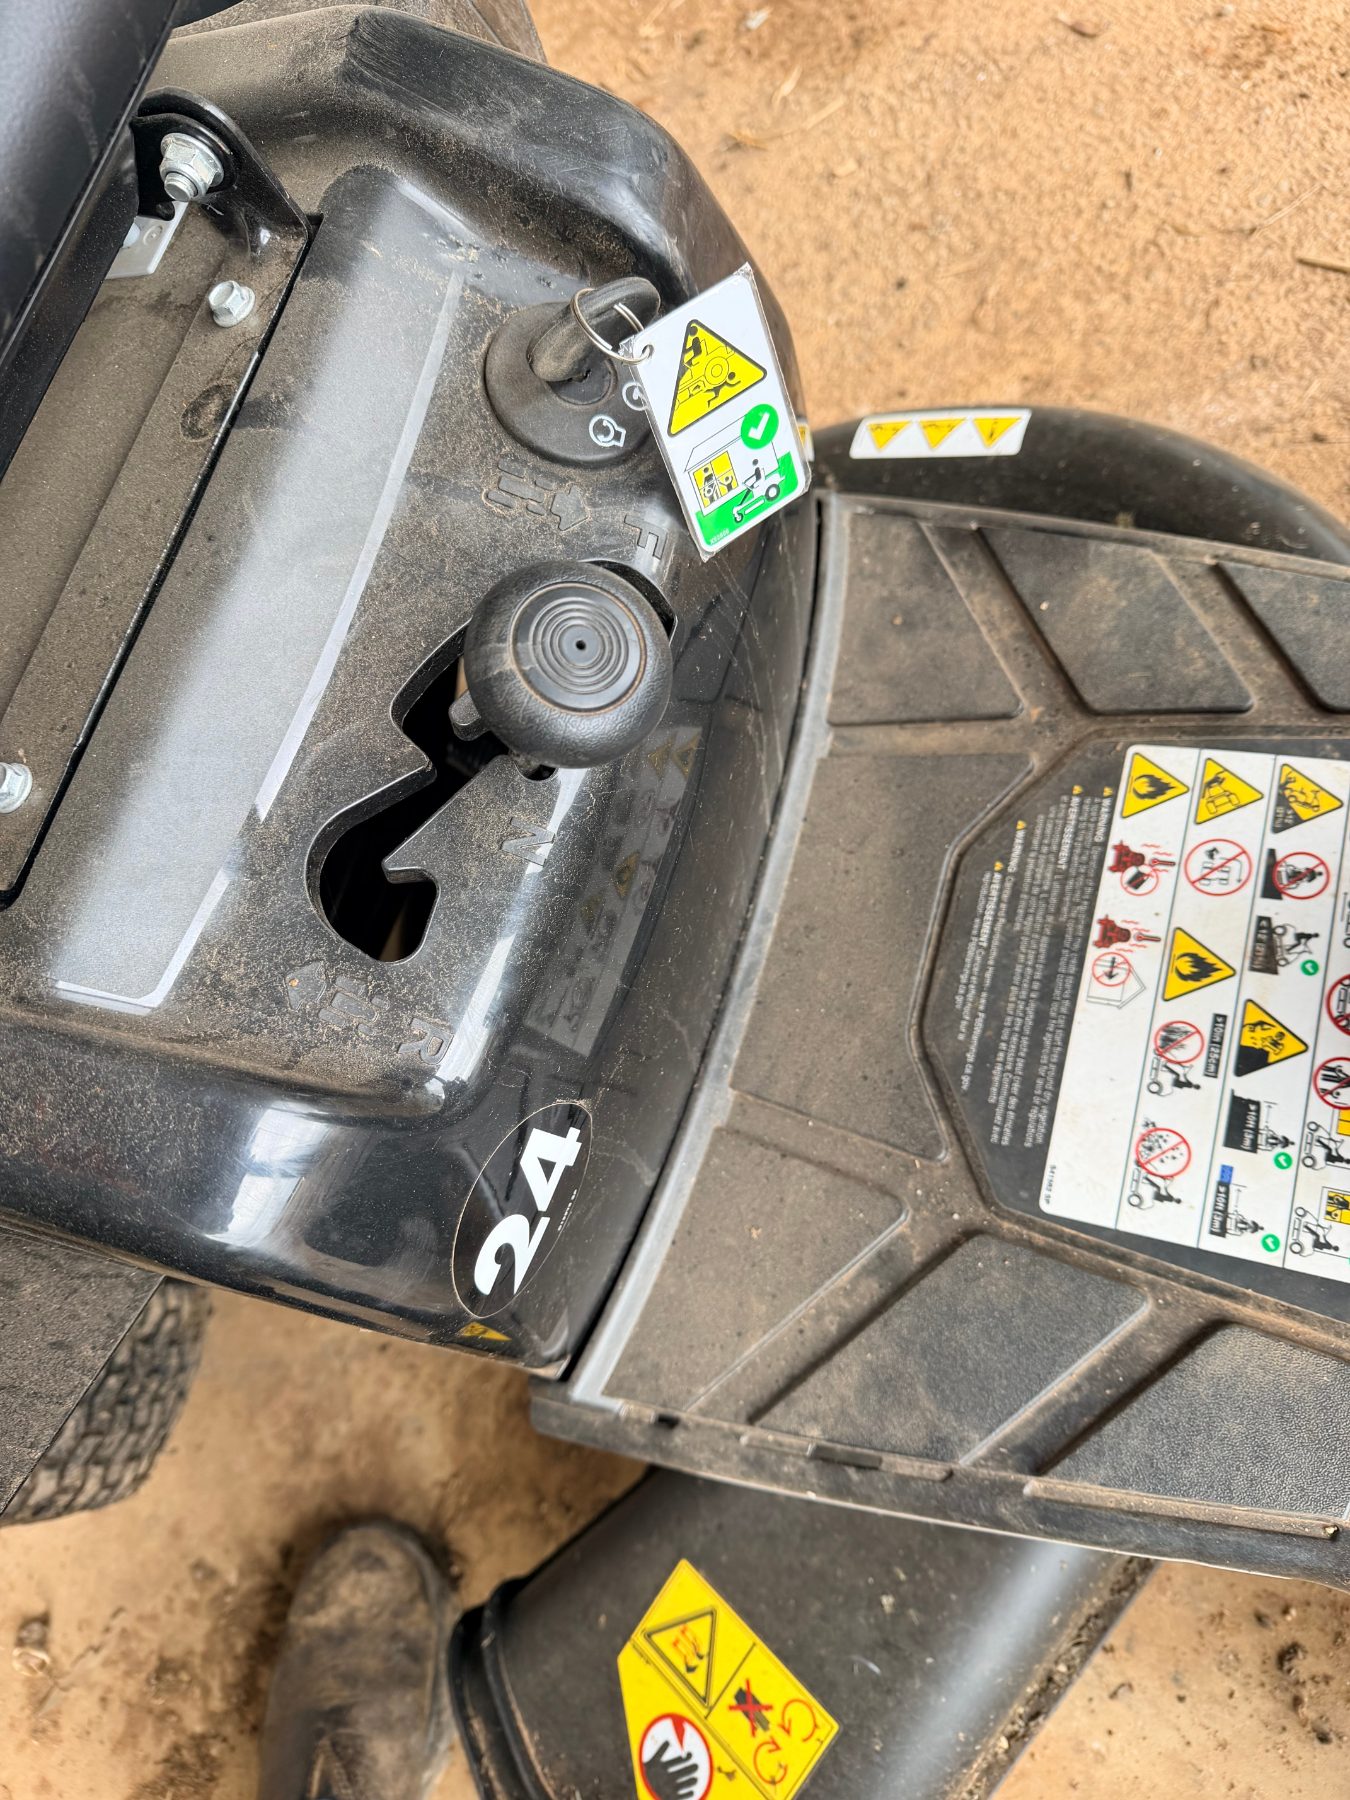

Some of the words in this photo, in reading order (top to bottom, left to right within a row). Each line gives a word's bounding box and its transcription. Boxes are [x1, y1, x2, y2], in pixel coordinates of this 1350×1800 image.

[623, 513, 670, 561] F
[499, 816, 556, 867] N
[1056, 795, 1080, 870] AVERTISSEMENT
[1094, 797, 1112, 842] WARNING
[1007, 828, 1025, 872] WARNING
[978, 872, 1001, 946] AVERTISSEMENT
[398, 1016, 455, 1065] R
[1211, 1015, 1225, 1042] >10in
[1203, 1043, 1220, 1076] (25cm)
[474, 1125, 584, 1297] 24
